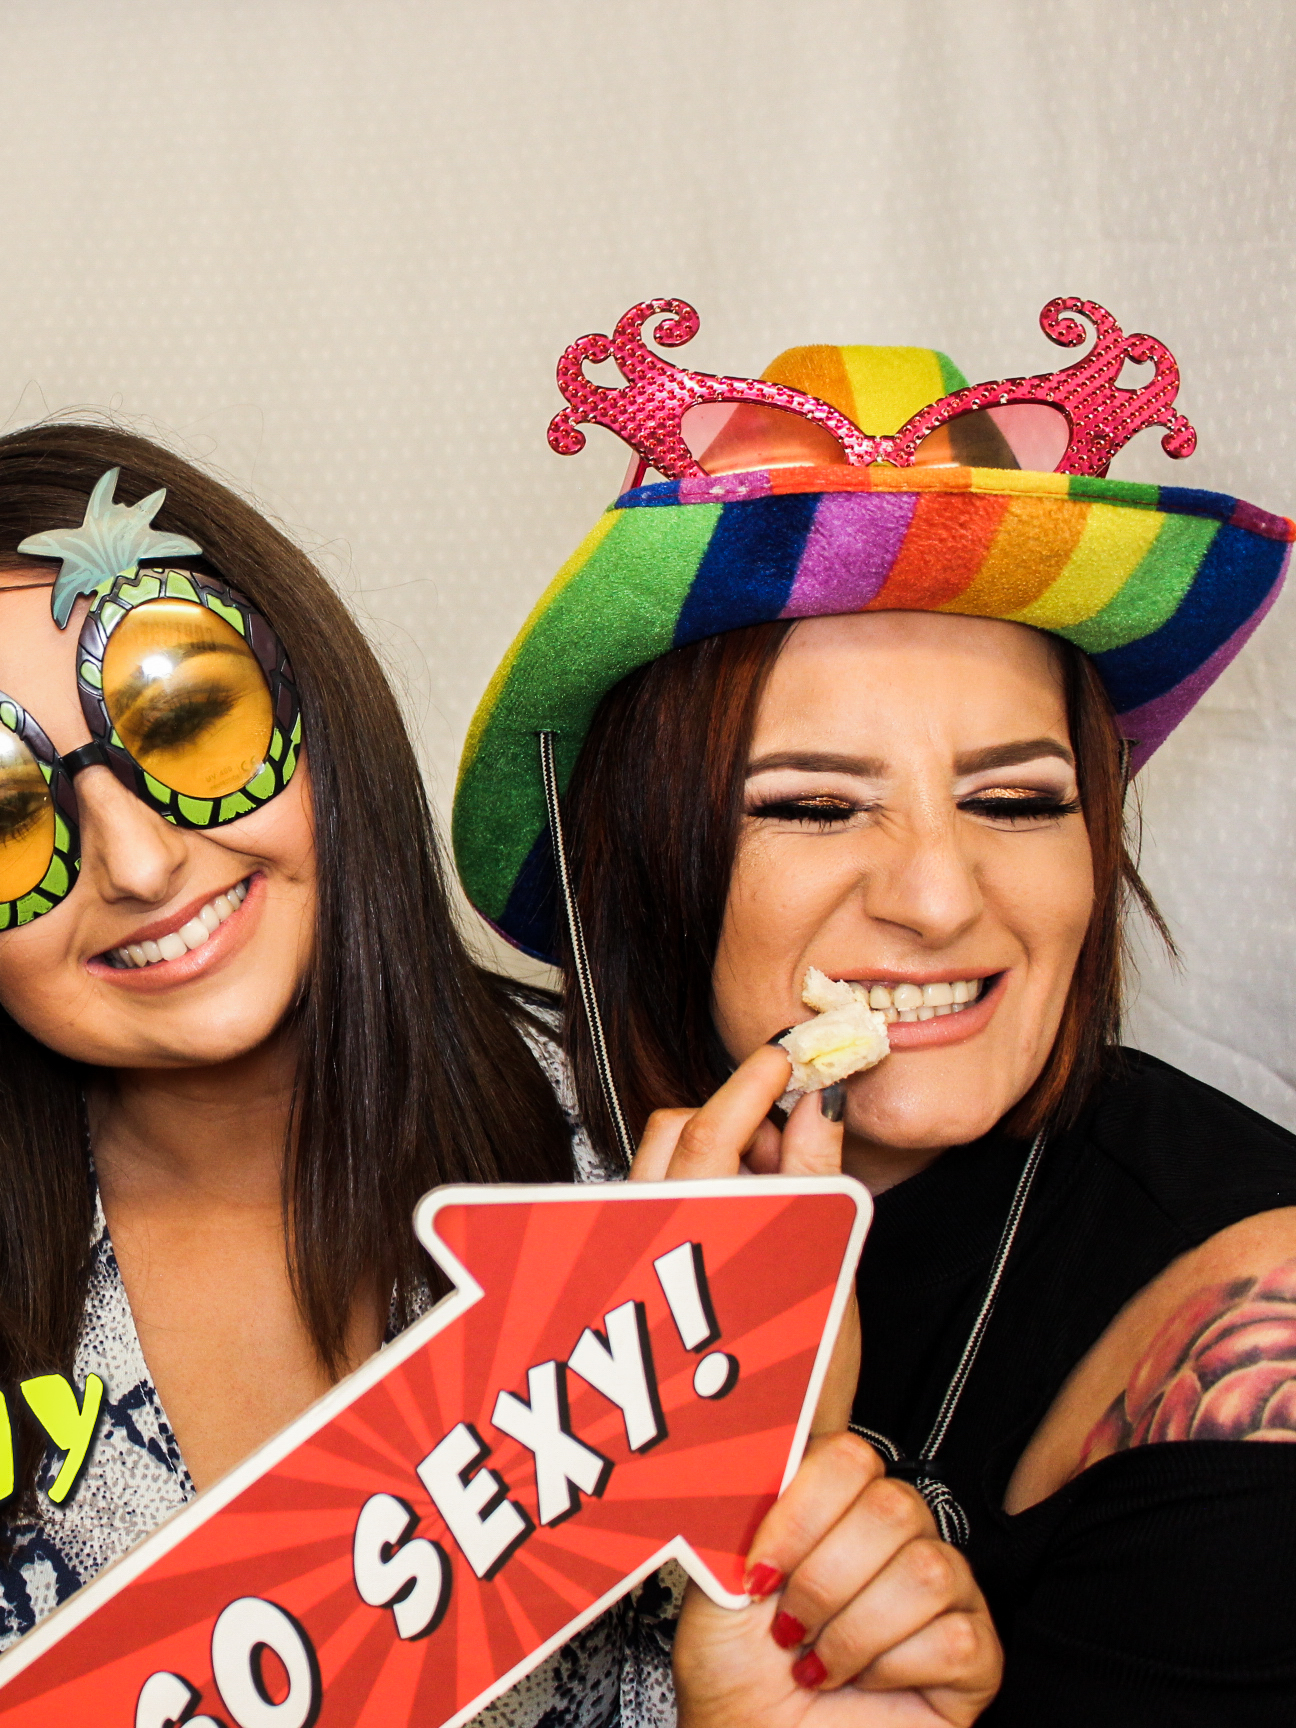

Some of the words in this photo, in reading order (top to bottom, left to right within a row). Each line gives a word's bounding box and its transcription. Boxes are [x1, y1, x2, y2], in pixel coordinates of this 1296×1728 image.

[205, 773, 216, 782] UV
[219, 766, 233, 776] 400
[353, 1241, 739, 1641] SEXY!
